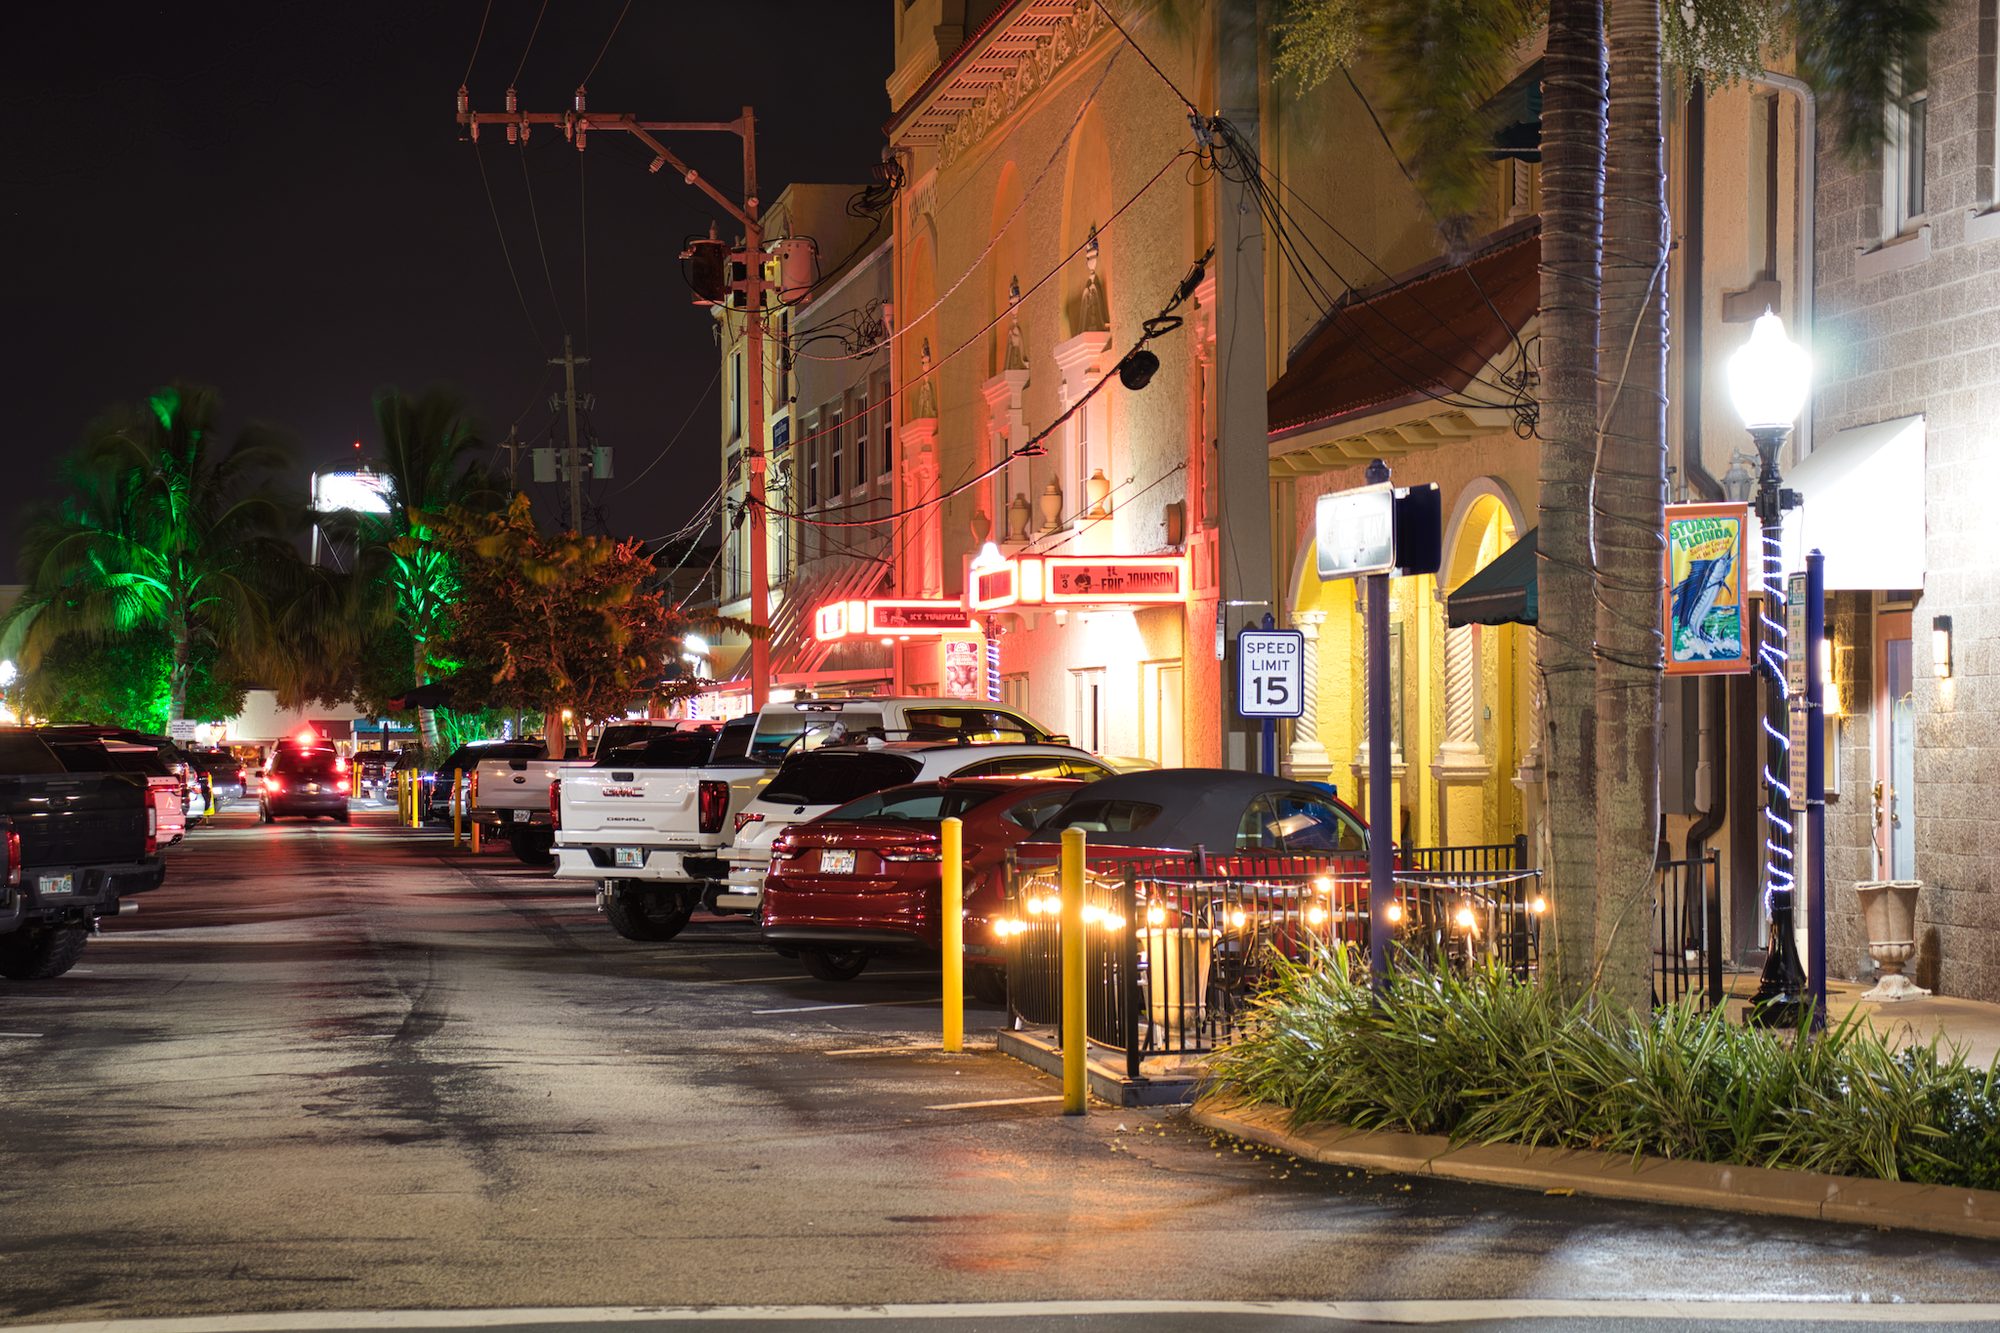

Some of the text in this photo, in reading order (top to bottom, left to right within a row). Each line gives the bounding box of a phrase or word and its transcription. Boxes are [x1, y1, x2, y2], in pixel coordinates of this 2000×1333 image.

[1669, 517, 1723, 540] STUART
[1679, 527, 1733, 552] FLORIDA
[1062, 579, 1069, 589] 3
[1101, 571, 1173, 591] ERIC JOHNSON
[1247, 642, 1296, 654] SPEED
[1252, 659, 1290, 671] LIMIT
[1253, 676, 1289, 705] 15
[603, 786, 645, 798] GMC
